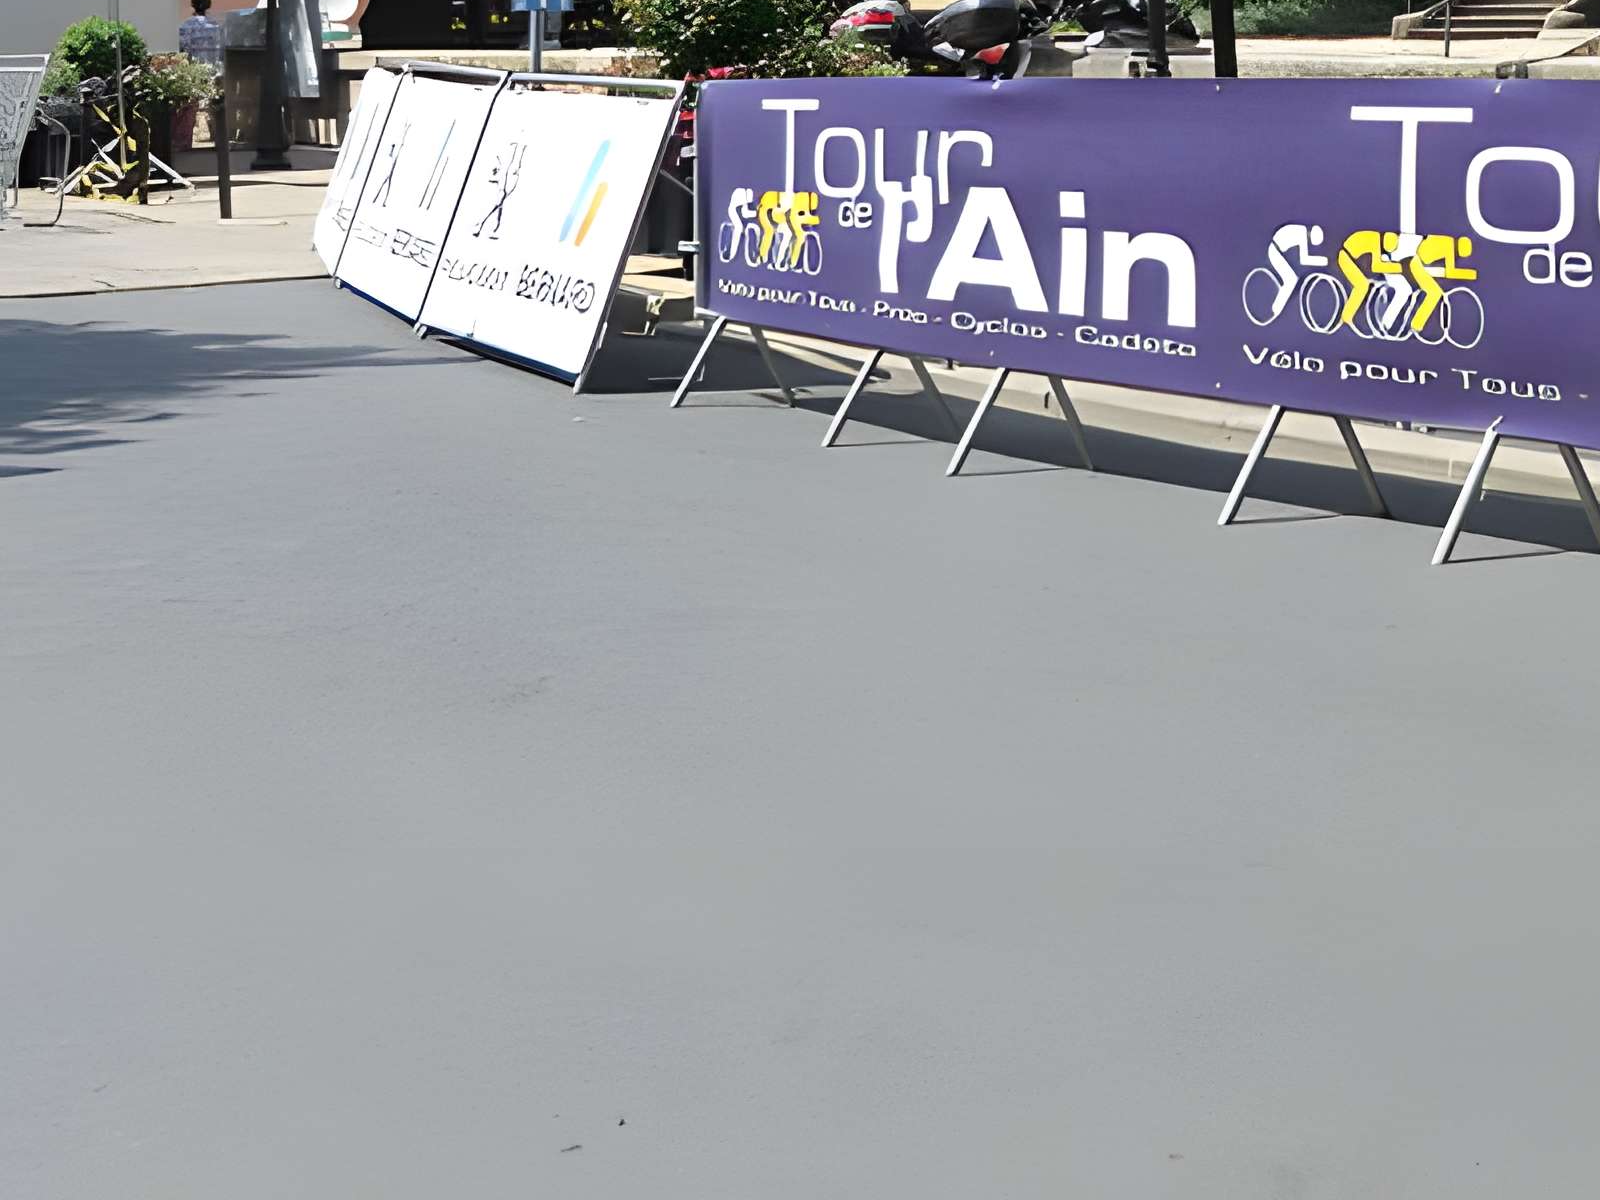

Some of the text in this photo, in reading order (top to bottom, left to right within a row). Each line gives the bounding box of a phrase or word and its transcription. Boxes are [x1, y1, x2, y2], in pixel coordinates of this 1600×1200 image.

[762, 98, 993, 205] Tour
[1523, 242, 1593, 288] de
[1340, 360, 1438, 384] pour
